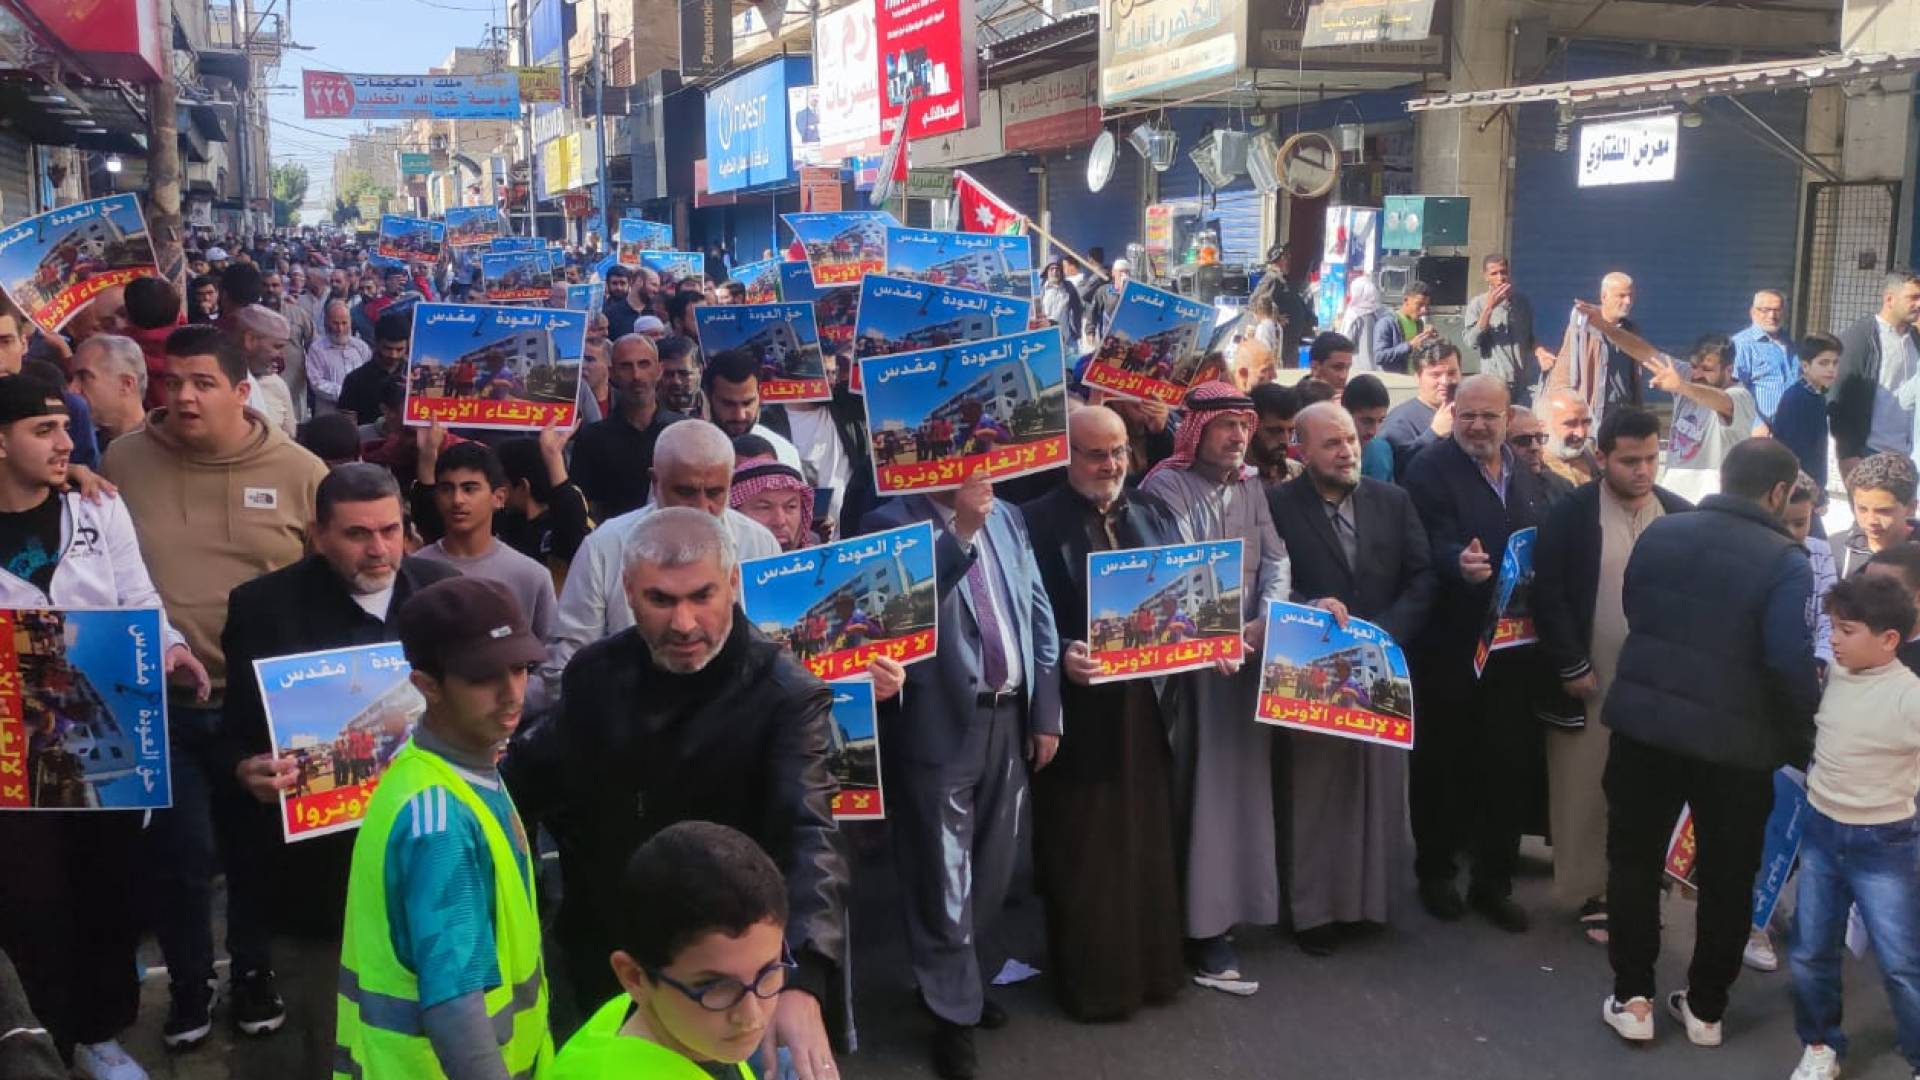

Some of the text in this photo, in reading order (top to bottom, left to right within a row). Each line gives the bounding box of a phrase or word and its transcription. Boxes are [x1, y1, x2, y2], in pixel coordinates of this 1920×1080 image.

[51, 205, 96, 227] العودة
[101, 202, 124, 218] حق
[896, 232, 1017, 250] حق العودة مقدس
[873, 284, 1017, 318] حق العودة مقدس
[426, 309, 572, 331] حق العودة مقدس
[703, 307, 803, 325] حق العودة مقدس
[878, 340, 1047, 383] حق العودة مقدس
[552, 405, 569, 421] لا
[1044, 439, 1061, 456] لا
[757, 534, 920, 585] حق العودة مقدس
[1101, 547, 1231, 576] حق العودة مقدس
[1279, 611, 1325, 628] مقدس
[914, 633, 930, 650] لا
[1220, 639, 1235, 654] لا
[279, 658, 348, 689] مقدس
[127, 624, 161, 793] حق العودة مقدس
[1393, 722, 1408, 738] لا
